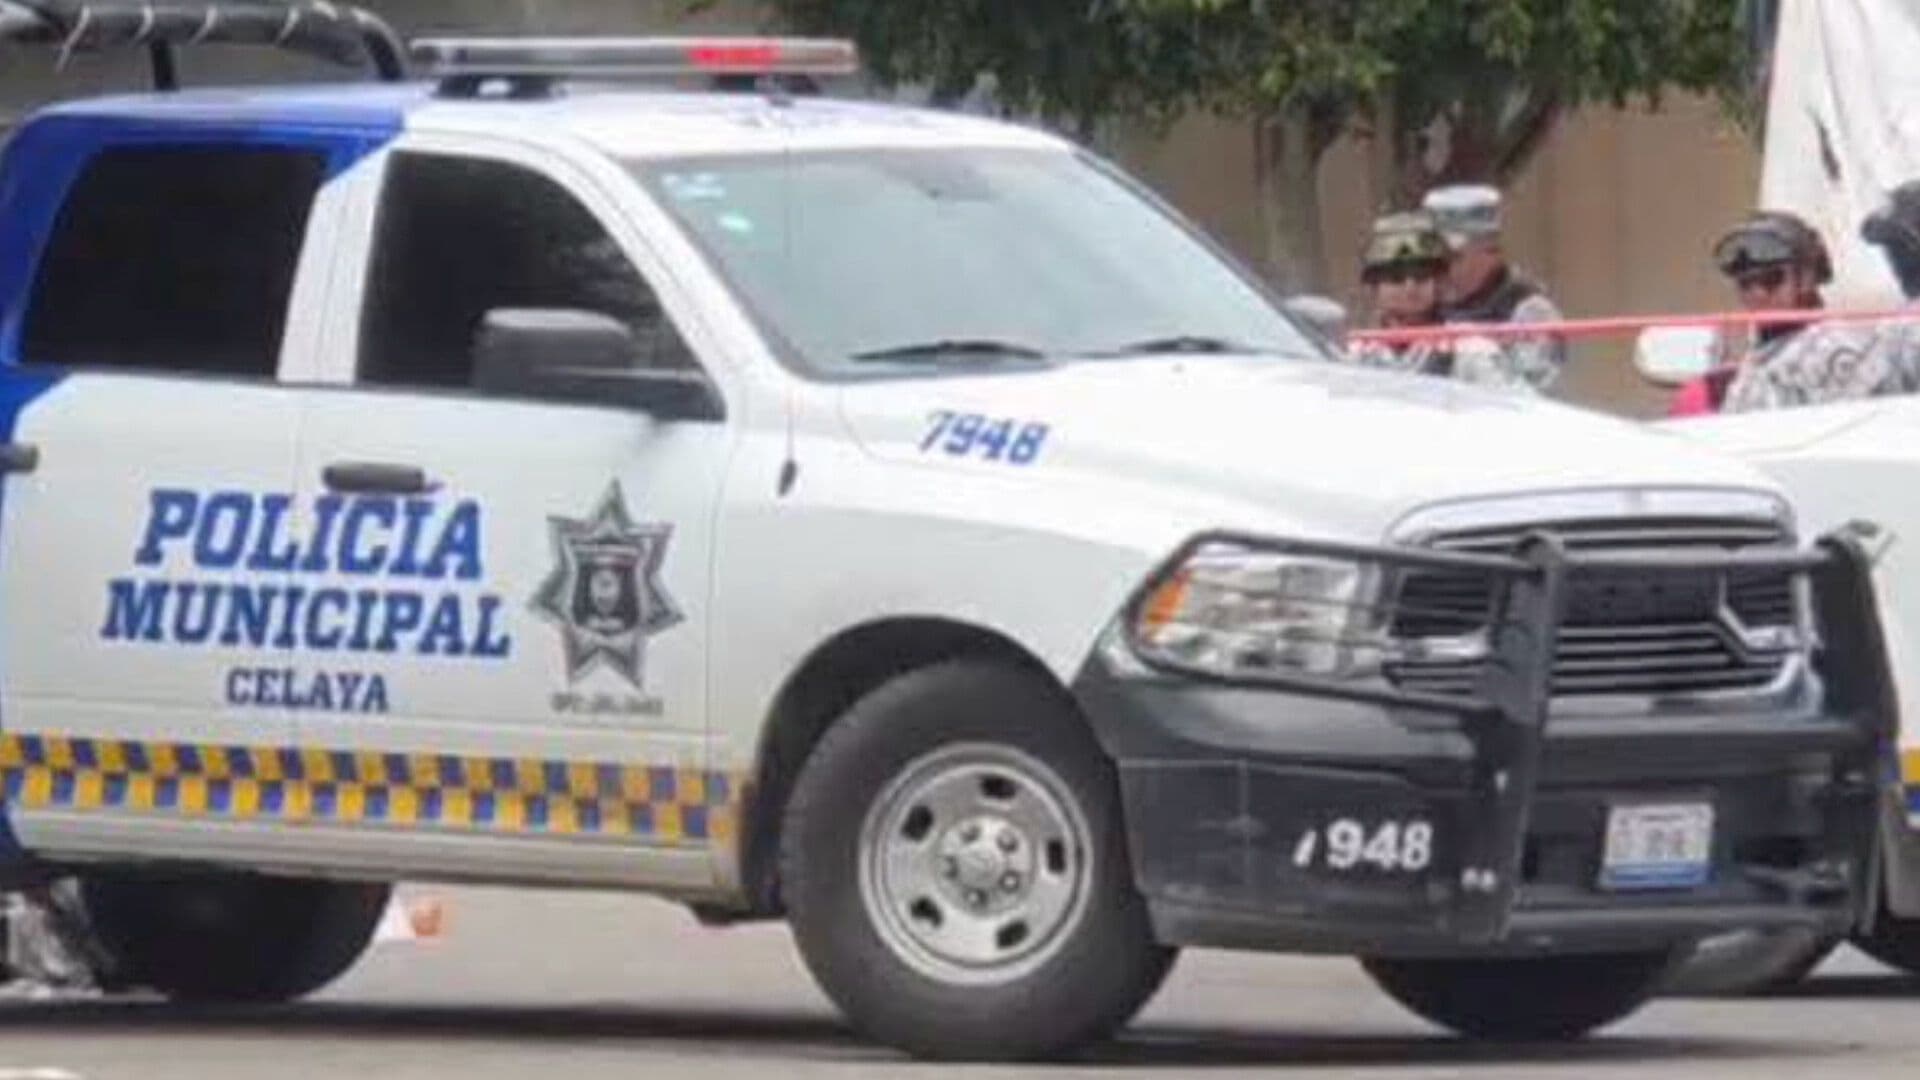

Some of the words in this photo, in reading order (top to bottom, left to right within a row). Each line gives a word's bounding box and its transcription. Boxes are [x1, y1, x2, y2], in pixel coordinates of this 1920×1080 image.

[919, 409, 1050, 464] 7948
[101, 579, 510, 657] MUNICIPAL
[226, 667, 388, 711] CELAYA
